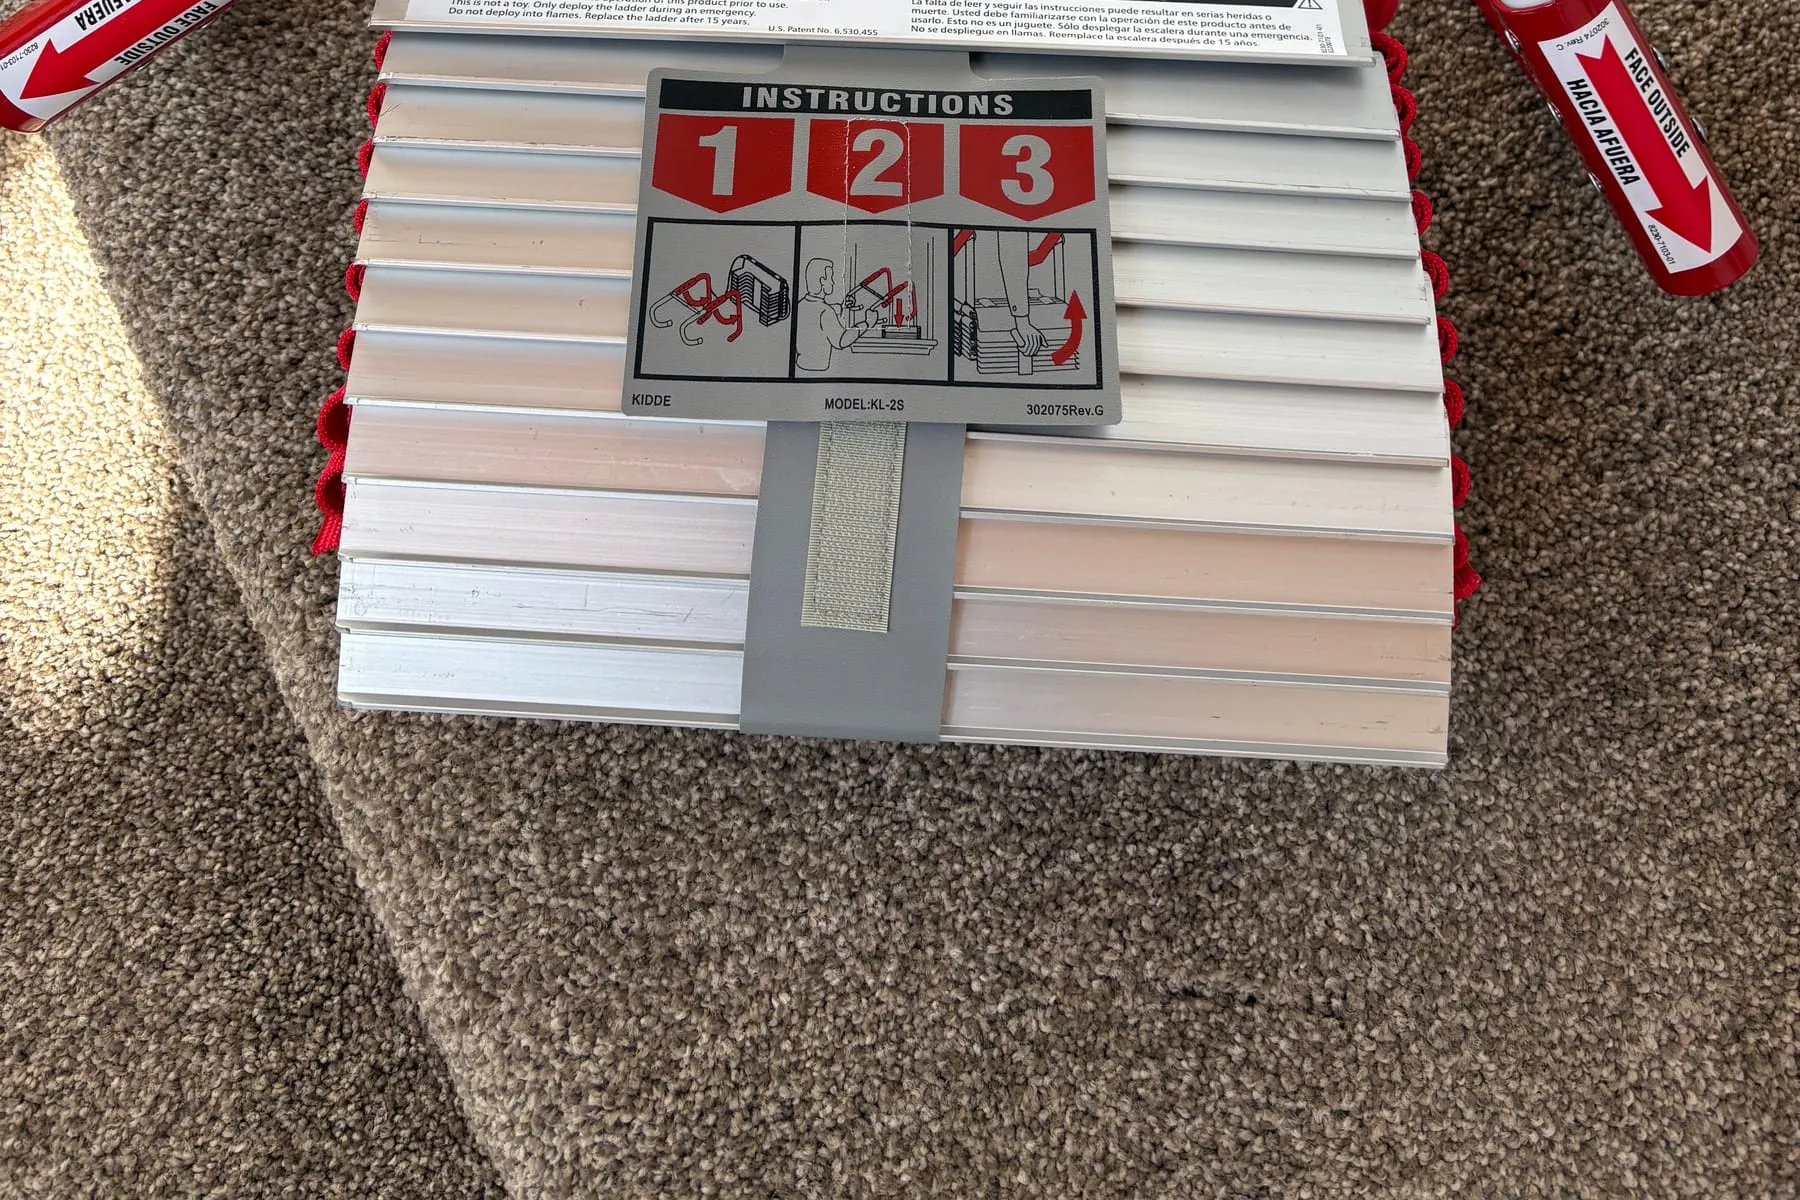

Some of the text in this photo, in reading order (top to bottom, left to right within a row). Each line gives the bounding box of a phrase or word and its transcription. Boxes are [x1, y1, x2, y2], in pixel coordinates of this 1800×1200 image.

[512, 0, 531, 10] toy.
[533, 0, 558, 11] Only
[558, 1, 594, 15] deploy
[595, 2, 613, 12] the
[614, 3, 648, 13] ladder
[648, 4, 683, 16] during
[699, 8, 757, 18] emergency.
[728, 0, 755, 9] prior
[756, 0, 767, 9] to
[949, 0, 963, 8] de
[964, 0, 983, 8] leer
[984, 2, 991, 10] y
[992, 1, 1023, 14] seguir
[1024, 2, 1039, 11] las
[1040, 3, 1106, 14] instrucciones
[1107, 7, 1140, 16] puede
[1141, 8, 1180, 17] resultar
[1195, 11, 1225, 19] serias
[1225, 11, 1264, 21] heridas
[446, 6, 750, 27] Do not deploy into flames. Replace the ladder after 15 years.
[911, 8, 947, 16] muerte.
[952, 8, 981, 17] Usted
[982, 9, 1009, 19] debe
[1010, 10, 1077, 22] familiarizarse
[1098, 14, 1109, 23] la
[1110, 16, 1161, 25] operación
[1162, 17, 1176, 26] de
[1177, 19, 1199, 27] este
[1200, 20, 1247, 29] producto
[1248, 22, 1277, 30] antes
[1278, 23, 1292, 31] de
[114, 2, 219, 65] FACE OUTSIDE
[787, 25, 816, 33] Patent
[833, 27, 881, 36] 6,530,455
[910, 16, 945, 25] usarlo.
[946, 17, 969, 26] Esto
[1012, 20, 1056, 32] juguete.
[1057, 22, 1080, 31] Sólo
[1081, 23, 1131, 34] desplegar
[1132, 25, 1142, 33] la
[1144, 26, 1185, 36] escalera
[1186, 27, 1228, 37] durante
[1250, 32, 1313, 42] emergencia.
[910, 24, 926, 33] No
[940, 26, 995, 37] despliegue
[1011, 28, 1047, 38] llamas.
[1048, 30, 1104, 40] Reemplace
[1105, 33, 1115, 41] la
[1116, 34, 1158, 43] escalera
[1159, 35, 1201, 45] después
[1202, 37, 1216, 46] de
[1218, 38, 1232, 46] 15
[1233, 39, 1258, 47] años.
[743, 87, 1012, 115] INSTRUCTIONS
[1625, 48, 1689, 158] FACE OUTSIDE
[1567, 79, 1640, 185] HACIA AFUERA
[699, 126, 736, 195] 1
[851, 129, 904, 196] 2
[1001, 135, 1054, 205] 3
[1648, 224, 1675, 265] 8230-7103-01
[632, 394, 671, 406] KIDDE
[825, 398, 904, 410] MODEL:KL-2S
[1027, 404, 1103, 415] 302075Rev.G
